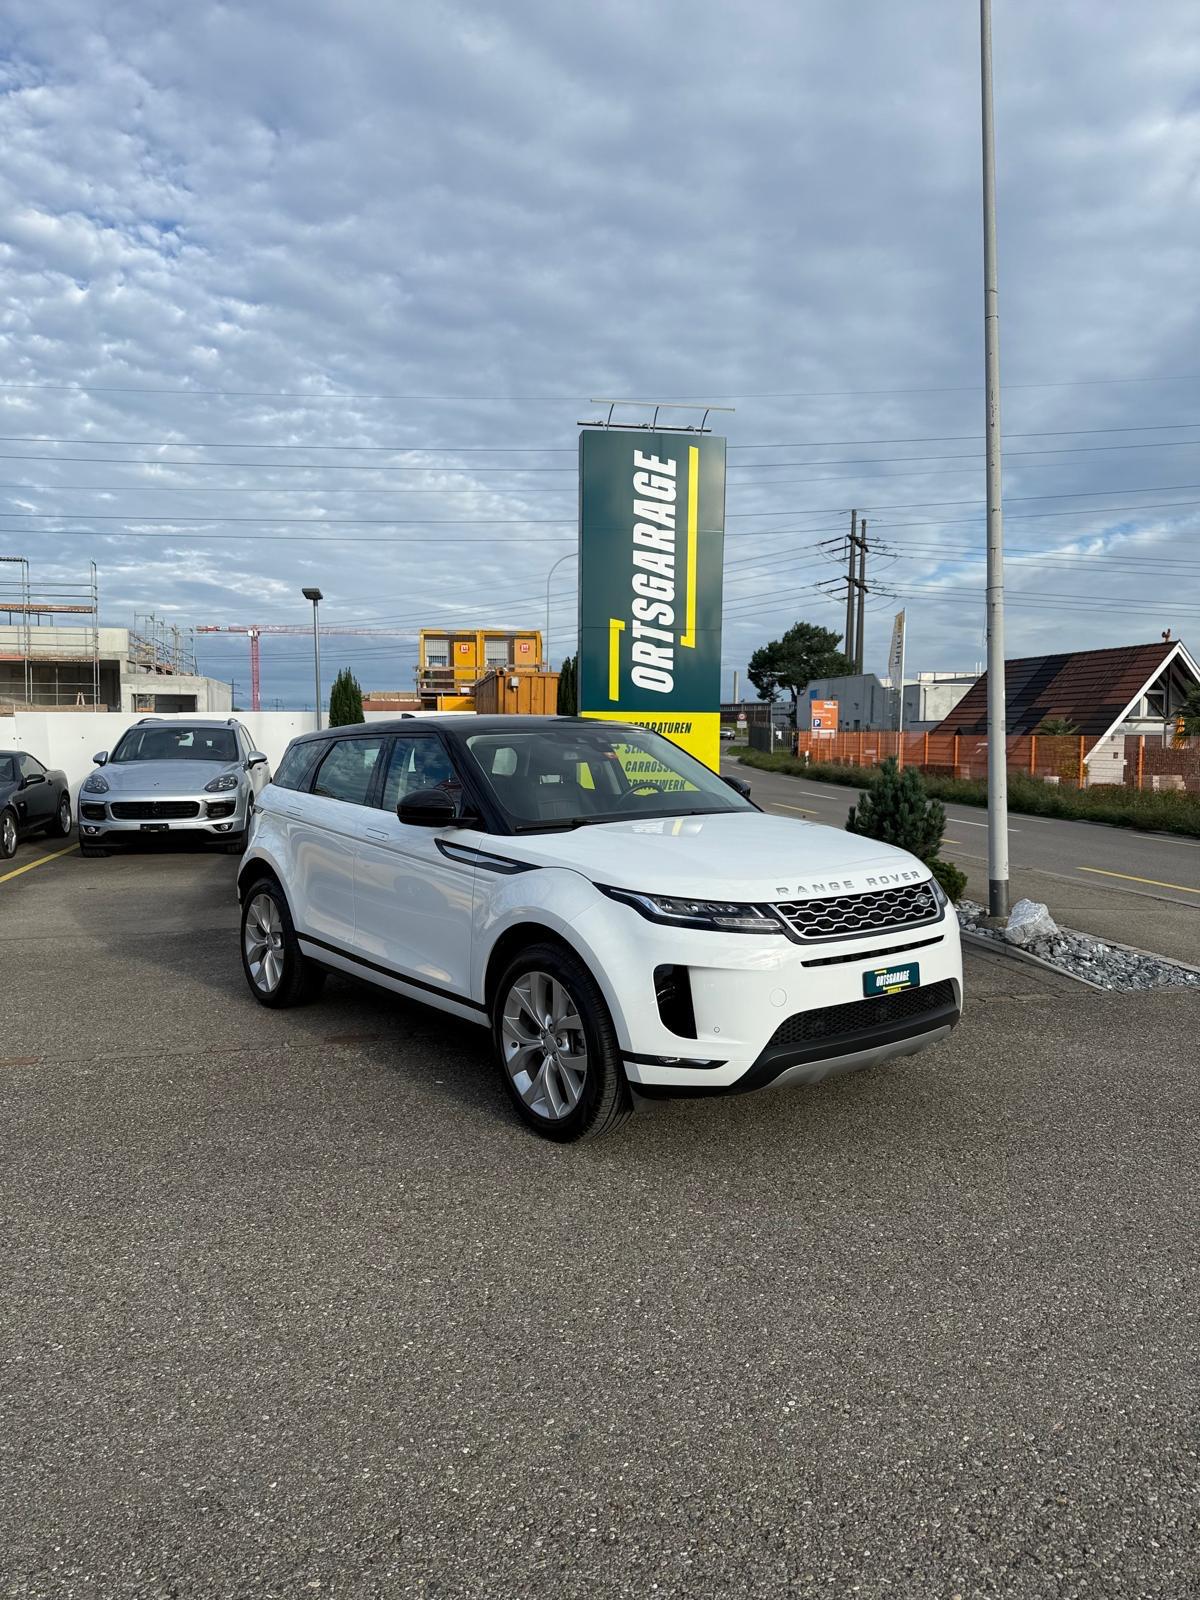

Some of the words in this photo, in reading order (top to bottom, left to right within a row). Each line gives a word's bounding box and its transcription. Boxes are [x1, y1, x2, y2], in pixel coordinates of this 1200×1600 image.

[631, 449, 677, 694] ORTSGARAGE
[776, 881, 855, 895] RANGE
[866, 871, 920, 886] ROVER
[876, 970, 910, 987] ORTSGARAGE
